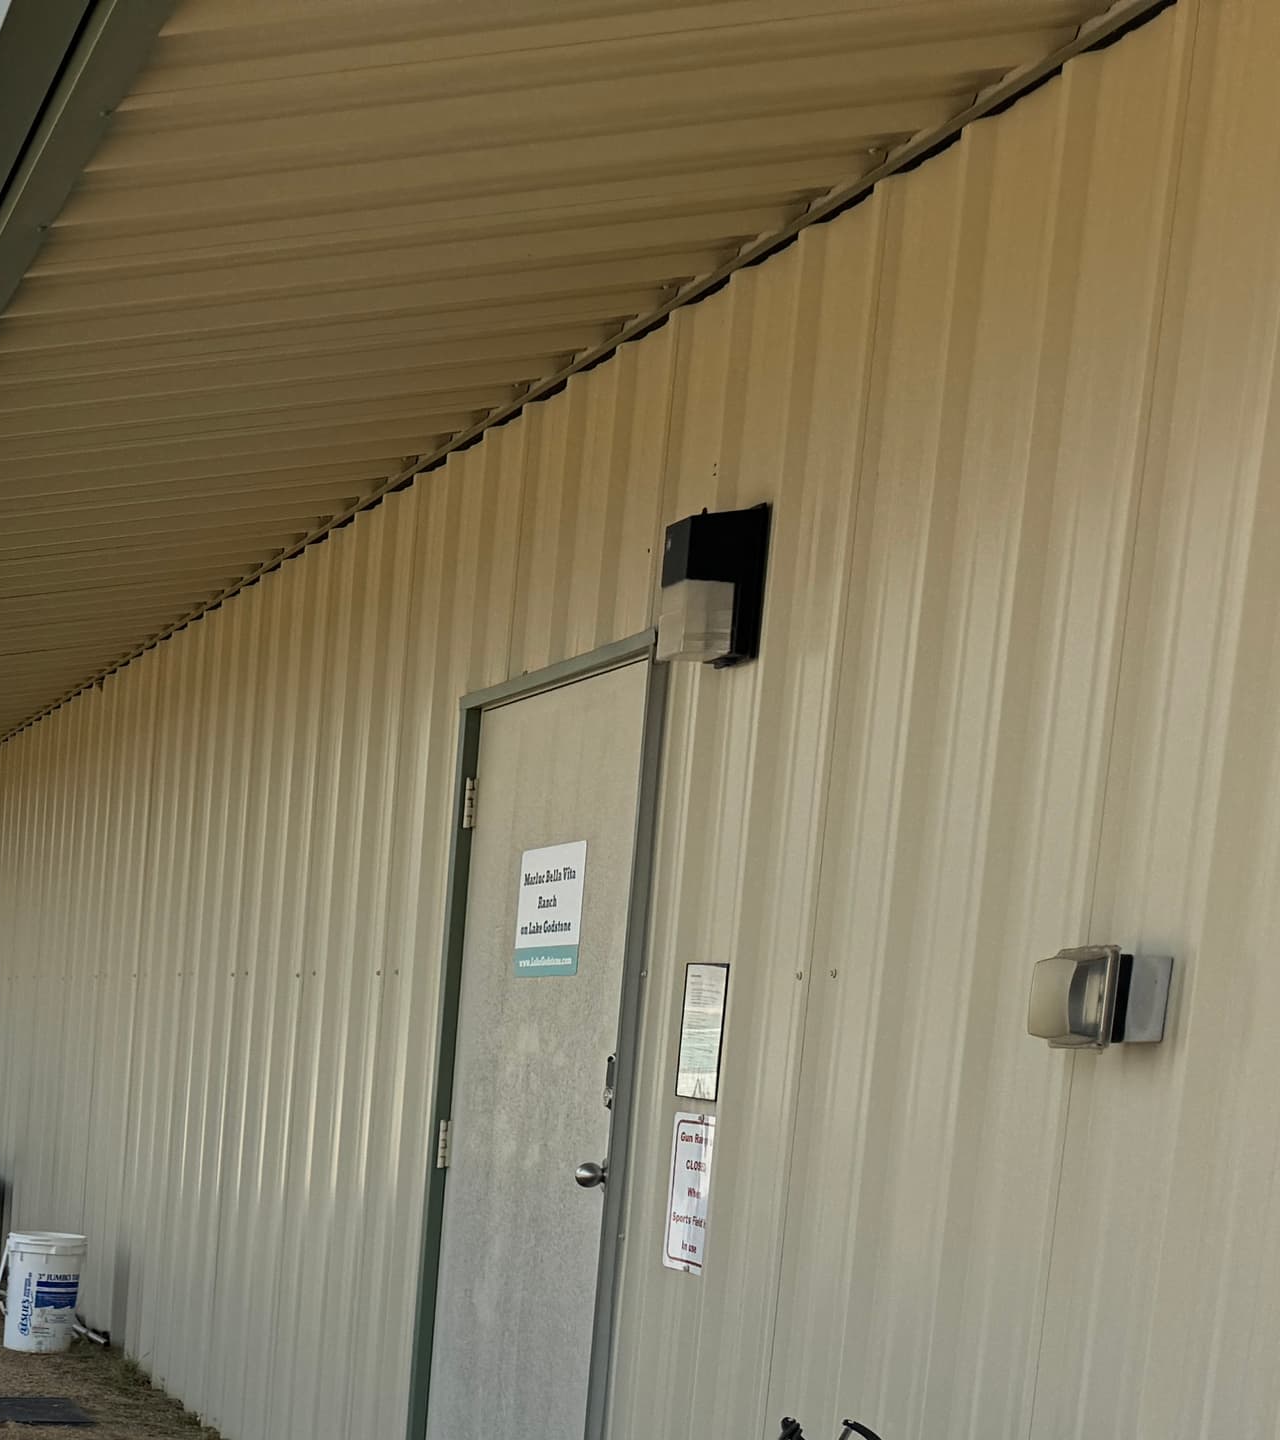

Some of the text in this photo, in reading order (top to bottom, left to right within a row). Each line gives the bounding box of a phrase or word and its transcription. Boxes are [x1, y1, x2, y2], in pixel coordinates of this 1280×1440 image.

[545, 869, 562, 883] Bella
[563, 867, 576, 880] Vita
[538, 895, 557, 909] Ranch
[528, 922, 542, 935] Lake
[681, 1131, 693, 1143] Gun
[673, 1211, 691, 1225] Sports
